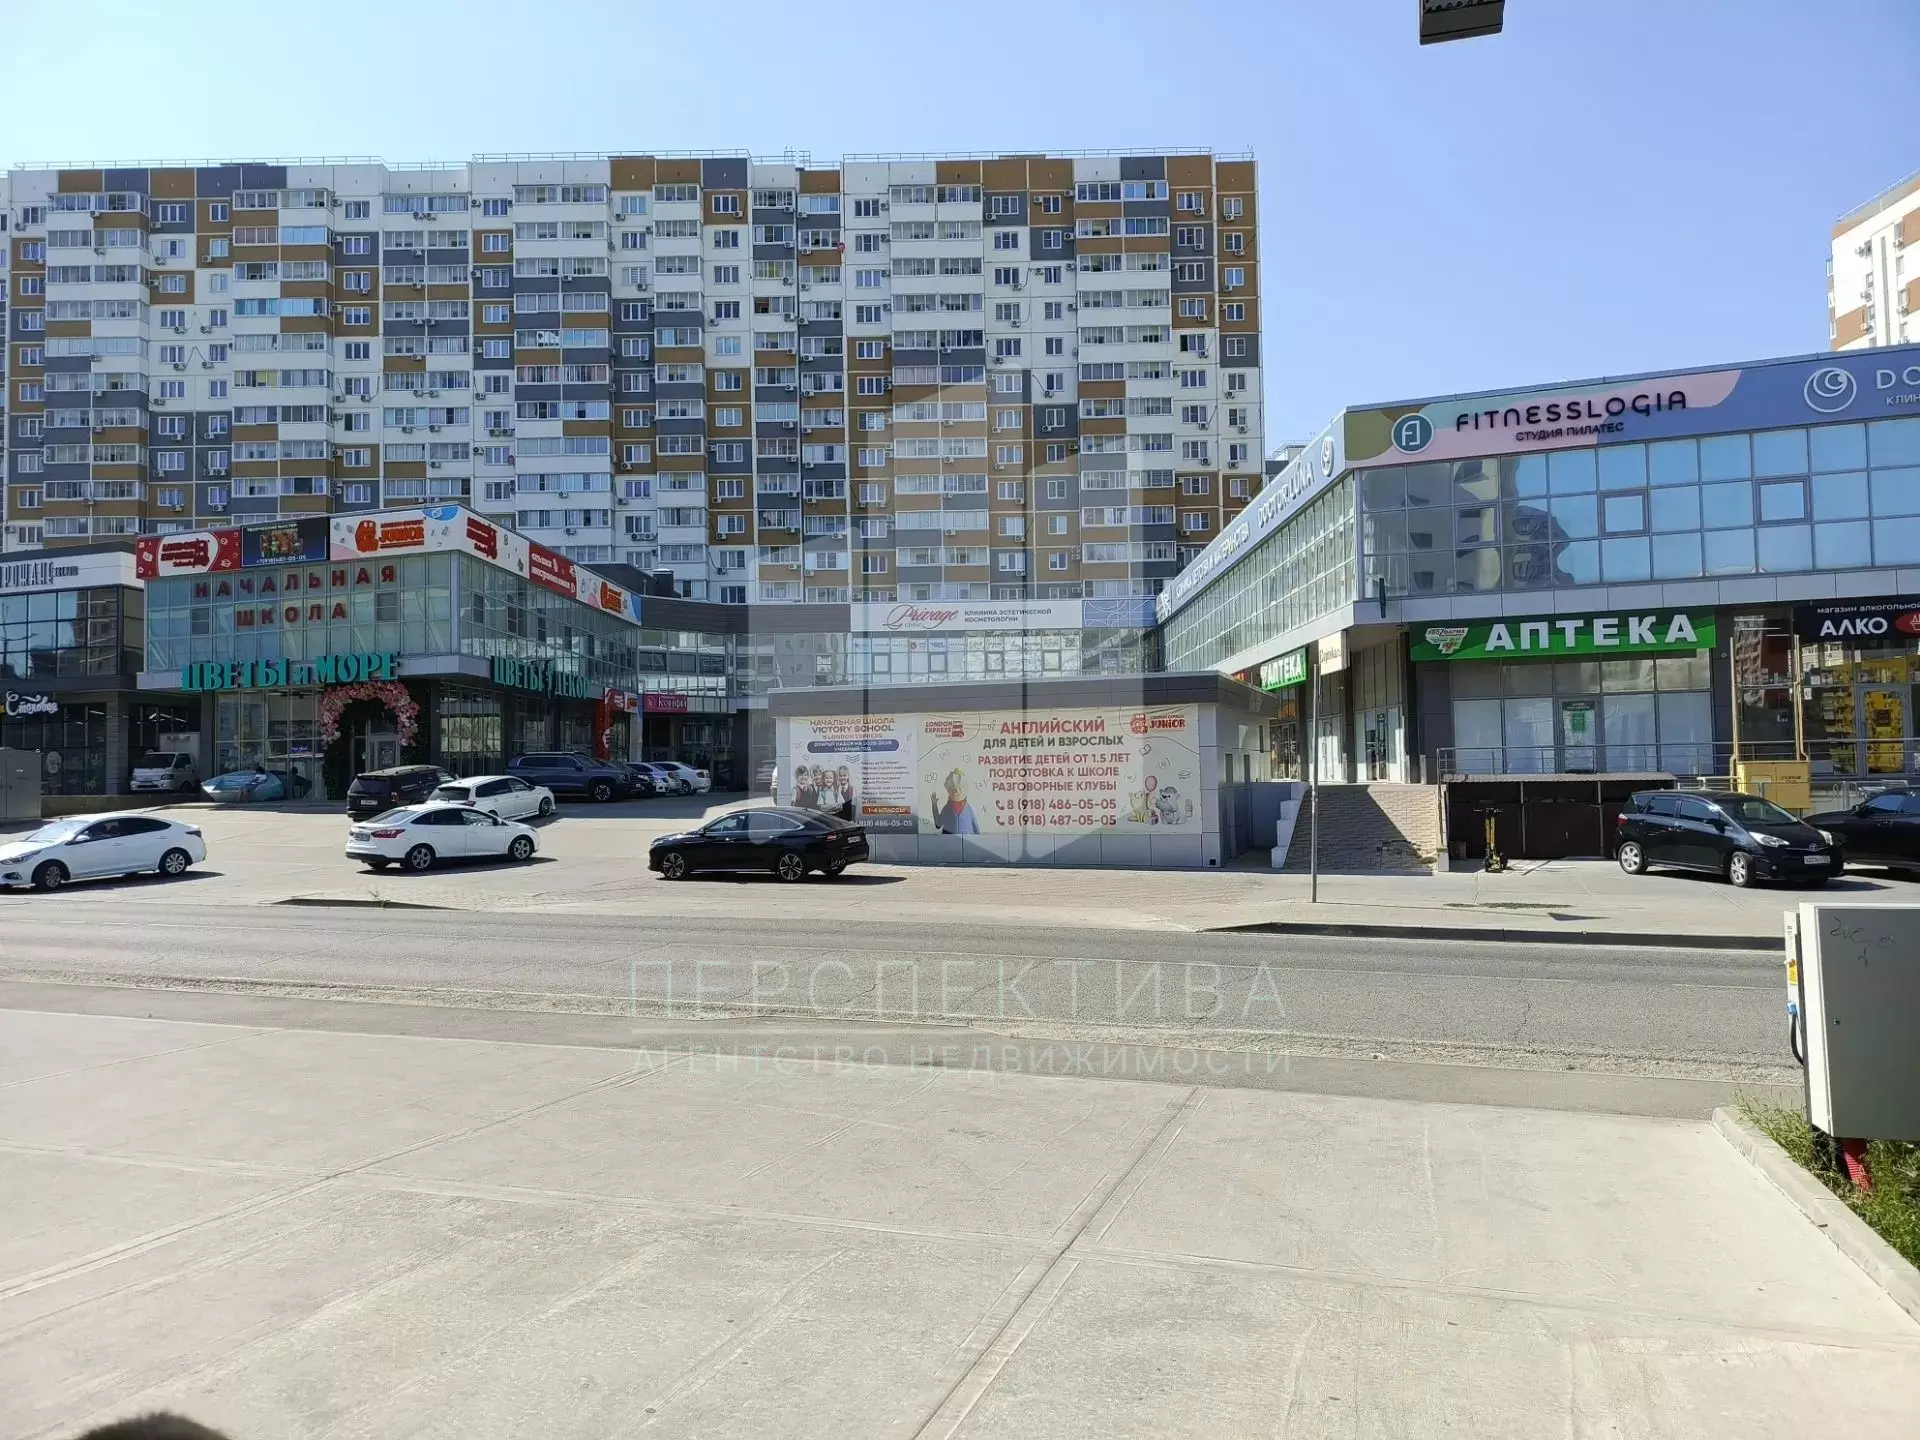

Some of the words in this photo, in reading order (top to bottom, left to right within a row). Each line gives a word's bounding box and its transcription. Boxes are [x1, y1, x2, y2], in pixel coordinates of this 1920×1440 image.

[1456, 390, 1687, 432] FITNESSLOGIA
[1516, 429, 1563, 441] СТУДИЯ
[1566, 422, 1624, 437] ПИЛАТЕС
[195, 569, 396, 598] НАЧАЛЬНАЯ
[237, 602, 346, 626] ШКОЛА
[964, 609, 998, 617] КЛИНИКА
[1817, 606, 1857, 614] магазин
[1485, 614, 1698, 651] АПТЕКА
[1820, 616, 1888, 637] АЛКО
[181, 657, 288, 693] ЦВЕТЫ
[315, 650, 401, 683] МОРЕ
[491, 656, 544, 692] ЦВЕТЫ
[809, 719, 861, 727] НАЧАЛЬНАЯ
[862, 717, 895, 725] ШКОЛА
[812, 725, 852, 734] VICTORY
[854, 724, 894, 733] SCHOOL
[1000, 716, 1105, 734] АНГЛИЙСКИЙ
[983, 738, 1007, 750] ДЛЯ
[1009, 736, 1044, 749] ДЕТЕЙ
[1047, 737, 1056, 747] И
[1058, 735, 1124, 747] ВЗРОСЛЫХ
[977, 755, 1033, 765] РАЗВИТИЕ
[1035, 752, 1070, 765] ДЕТЕЙ
[1073, 754, 1089, 763] ОТ
[1091, 754, 1107, 763] 1.5
[1109, 752, 1131, 763] ЛЕТ
[989, 767, 1064, 779] ПОДГОТОВКА
[1067, 767, 1075, 776] К
[1078, 767, 1120, 777] ШКОЛЕ
[992, 782, 1074, 792] РАЗГОВОРНЫЕ
[1076, 781, 1117, 791] КЛУБЫ
[1007, 799, 1015, 810] 8
[1018, 798, 1046, 811] (918)
[1048, 799, 1117, 810] 486-05-05
[1007, 814, 1016, 826] 8
[1018, 814, 1046, 827] (918)
[1049, 814, 1117, 826] 487-05-05
